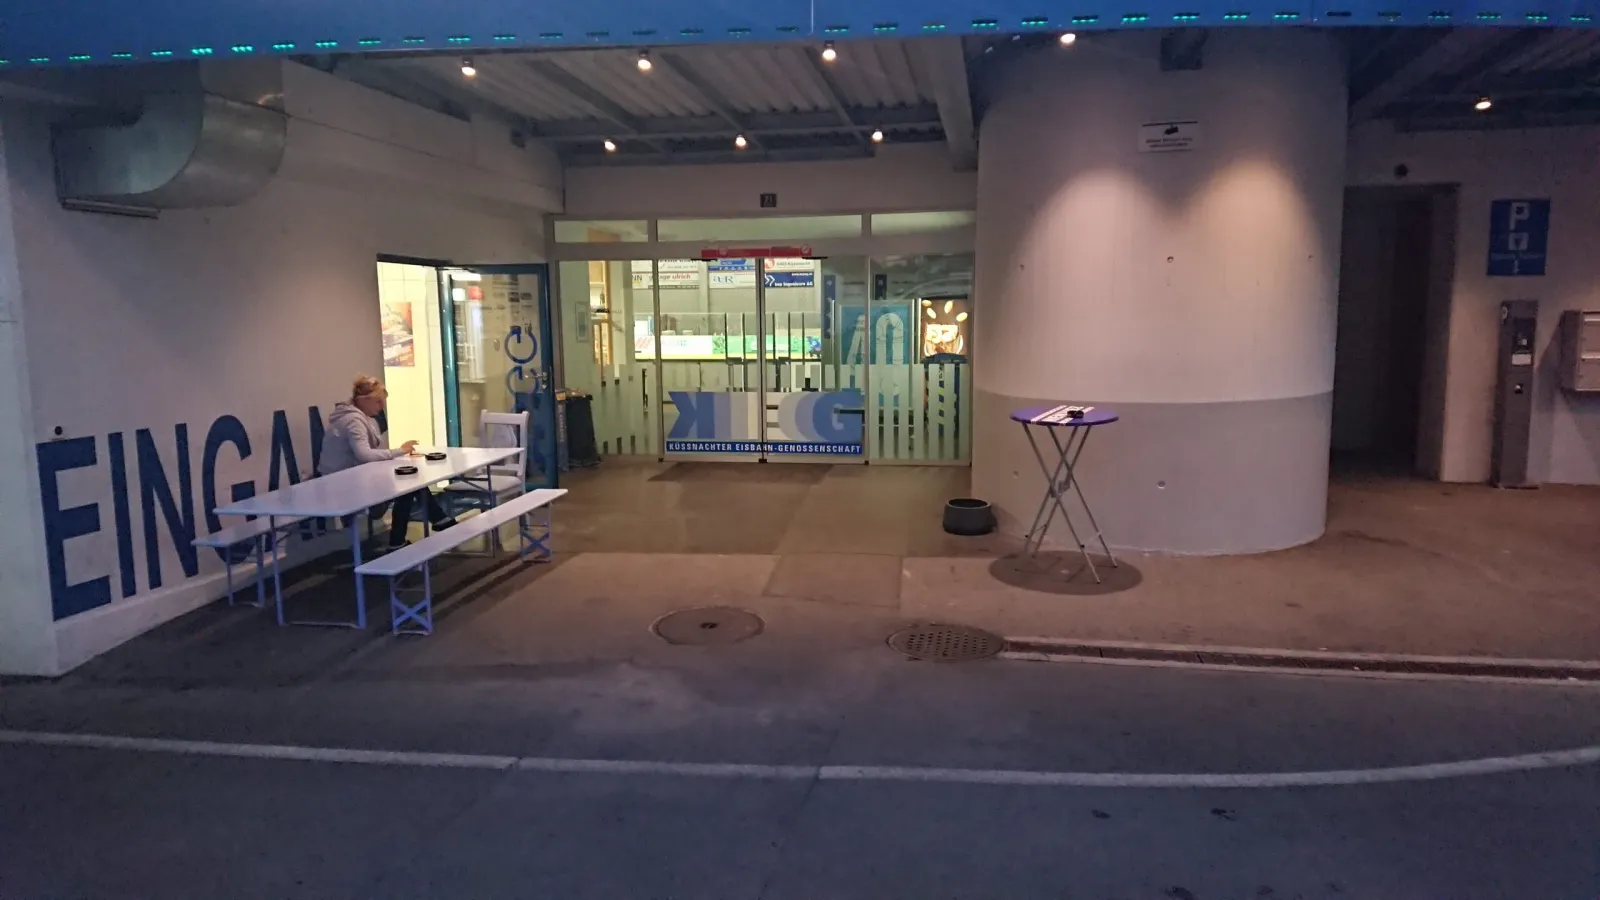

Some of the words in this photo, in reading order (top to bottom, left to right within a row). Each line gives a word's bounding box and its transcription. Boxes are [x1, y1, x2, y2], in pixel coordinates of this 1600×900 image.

[1509, 202, 1530, 231] P
[669, 442, 732, 451] KÜSSNACHTER
[735, 443, 861, 453] EISBAHN-GENOSSENSCHAFT
[36, 404, 388, 622] EINGA
